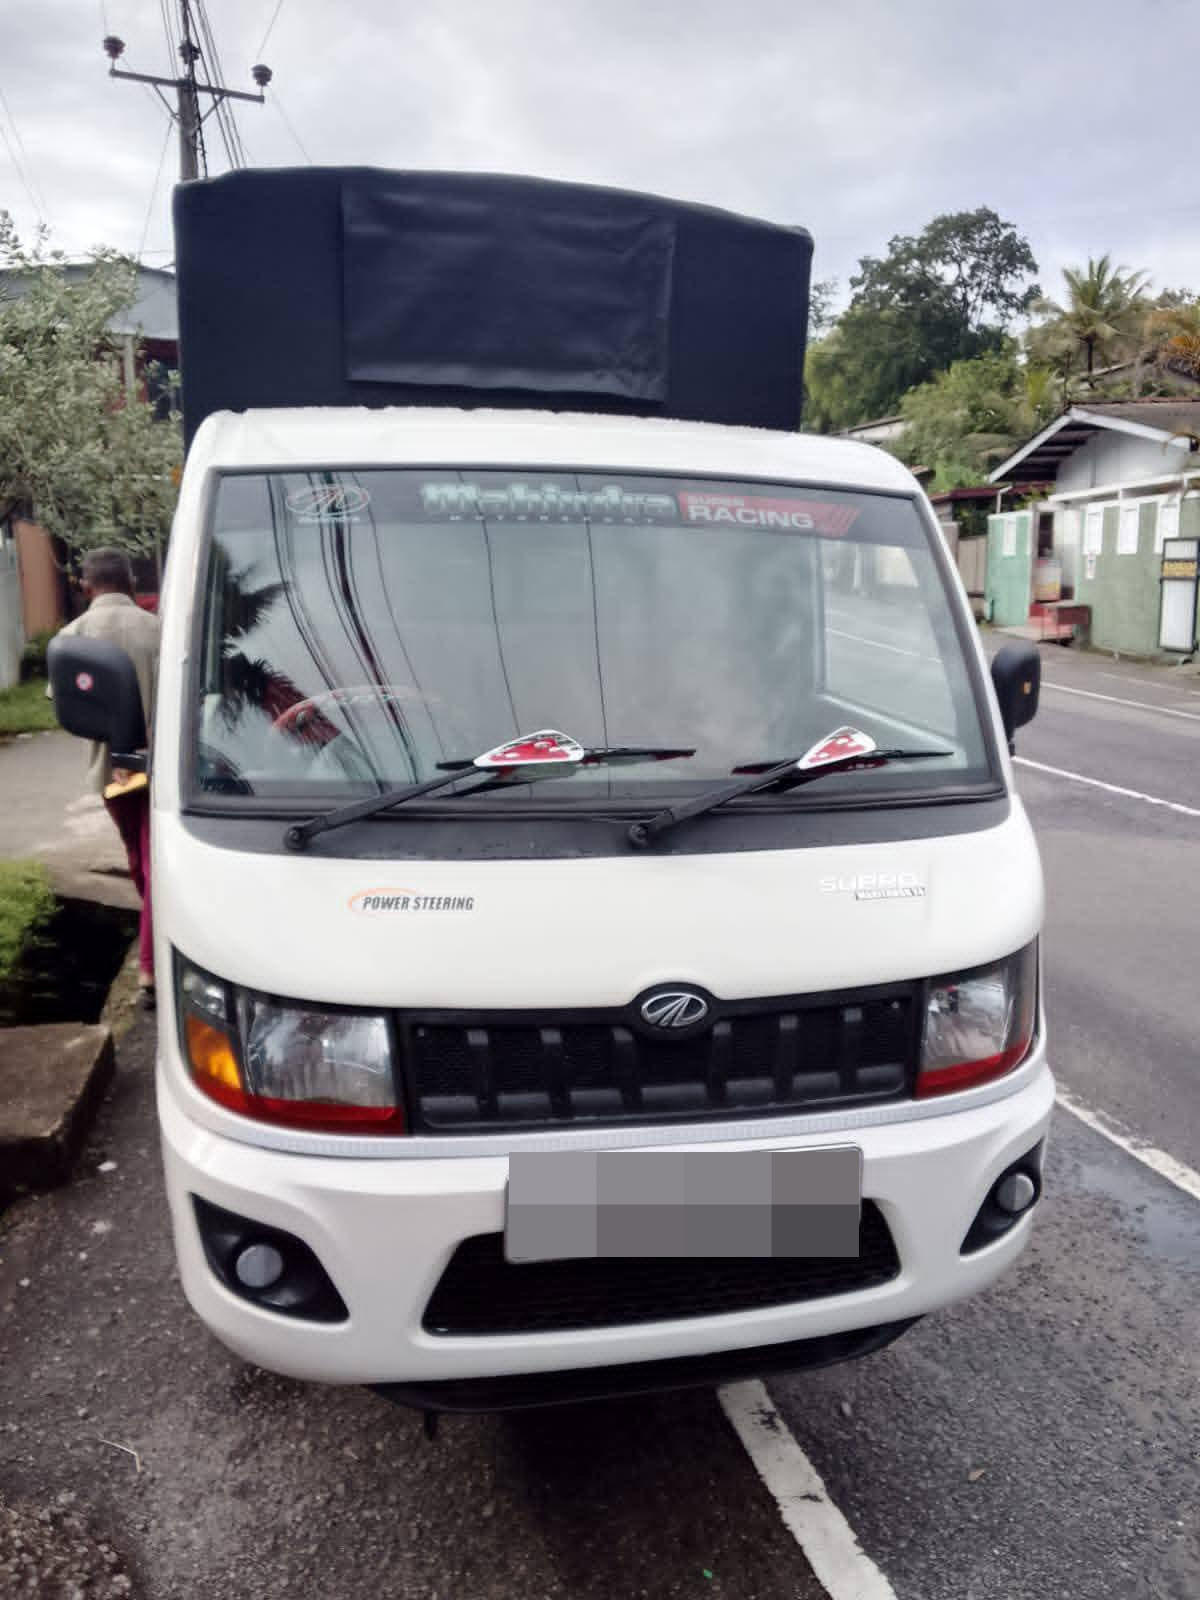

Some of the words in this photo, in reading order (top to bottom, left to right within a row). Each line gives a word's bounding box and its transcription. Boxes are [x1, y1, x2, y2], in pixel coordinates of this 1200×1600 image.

[688, 504, 815, 529] RACING
[362, 895, 410, 911] POWER
[412, 895, 475, 911] STEERING
